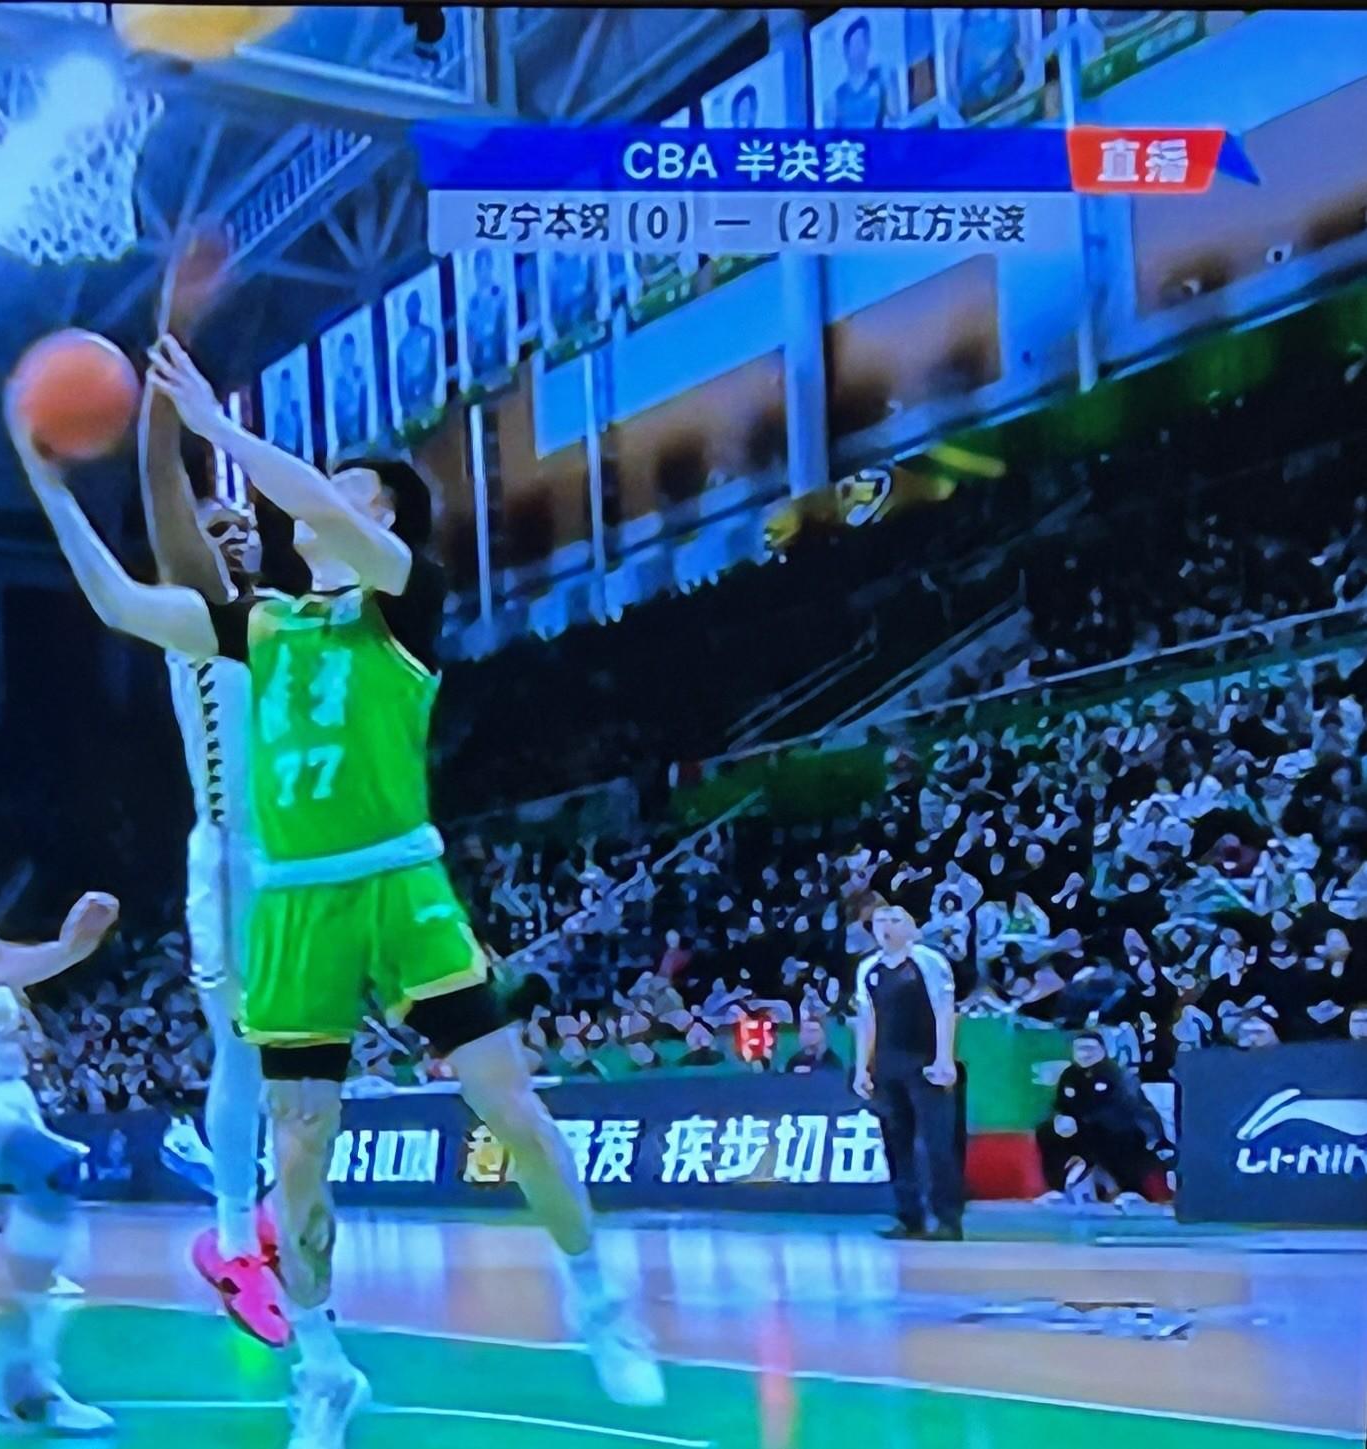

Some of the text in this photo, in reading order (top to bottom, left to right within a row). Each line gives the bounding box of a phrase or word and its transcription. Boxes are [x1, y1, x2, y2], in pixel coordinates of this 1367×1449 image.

[273, 743, 345, 808] 77
[660, 1107, 892, 1184] 疾步切击
